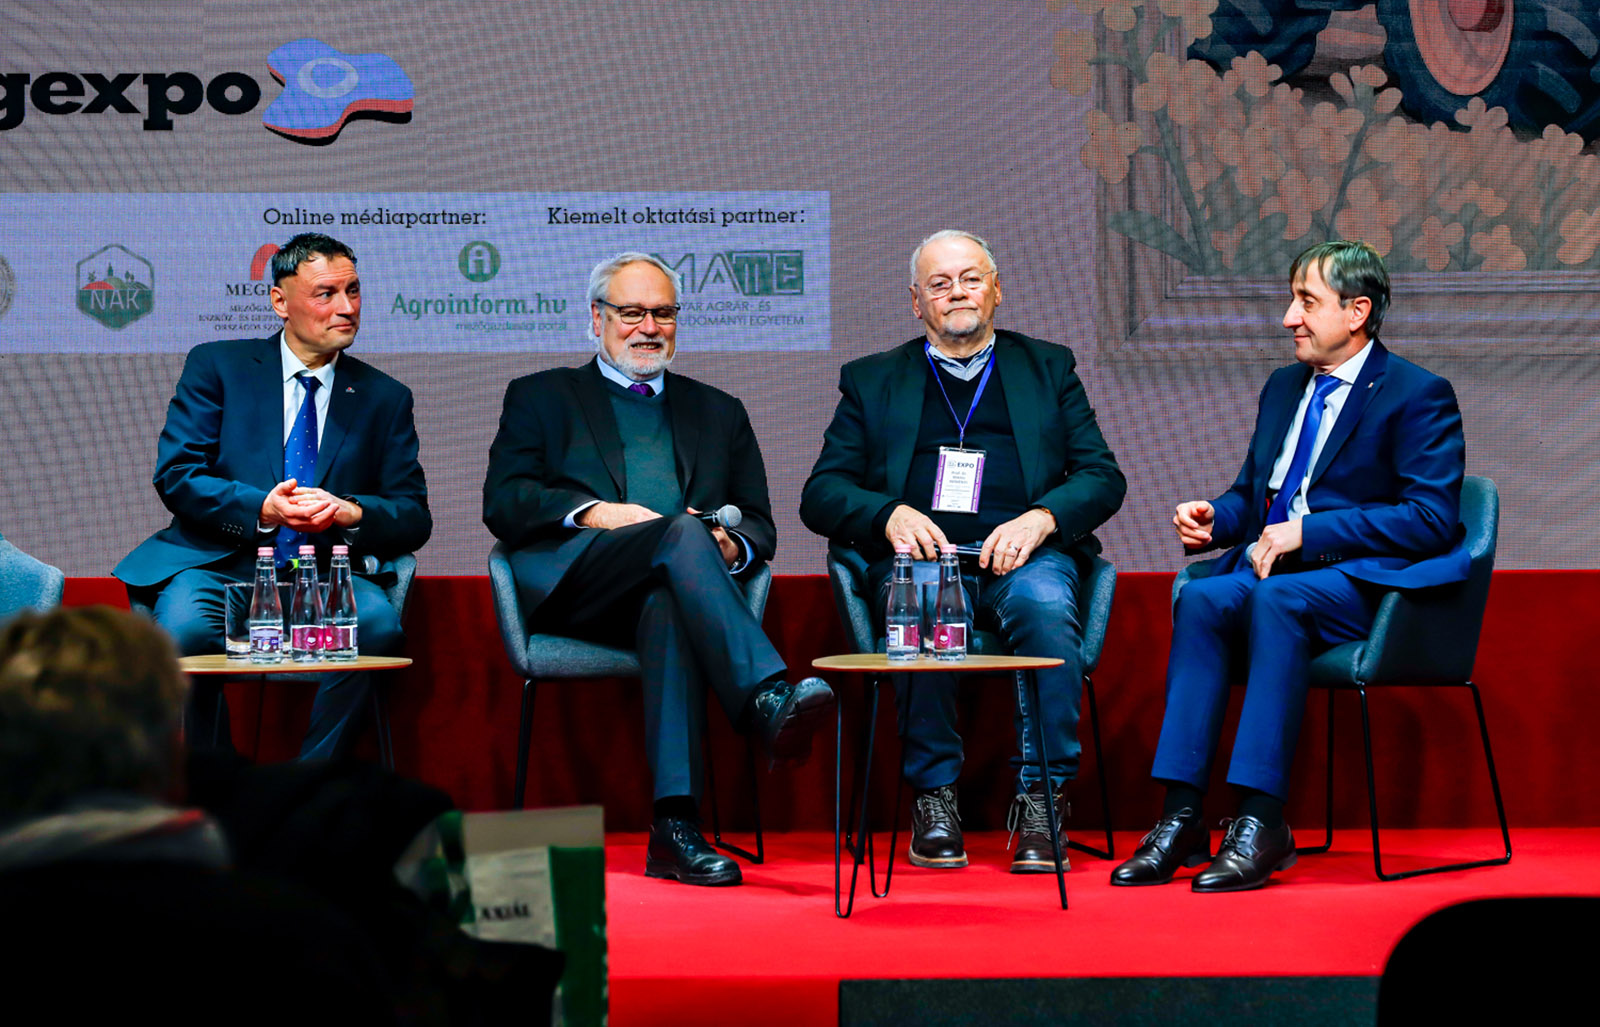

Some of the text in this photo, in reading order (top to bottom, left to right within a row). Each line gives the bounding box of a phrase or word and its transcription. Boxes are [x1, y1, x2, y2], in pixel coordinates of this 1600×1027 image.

[263, 207, 487, 229] Online médiapartner:
[547, 207, 806, 228] Kiemelt oktatási partner:
[90, 289, 140, 310] NAK
[390, 293, 568, 320] Agroinform.hu
[678, 314, 746, 326] UDOMÁNYI
